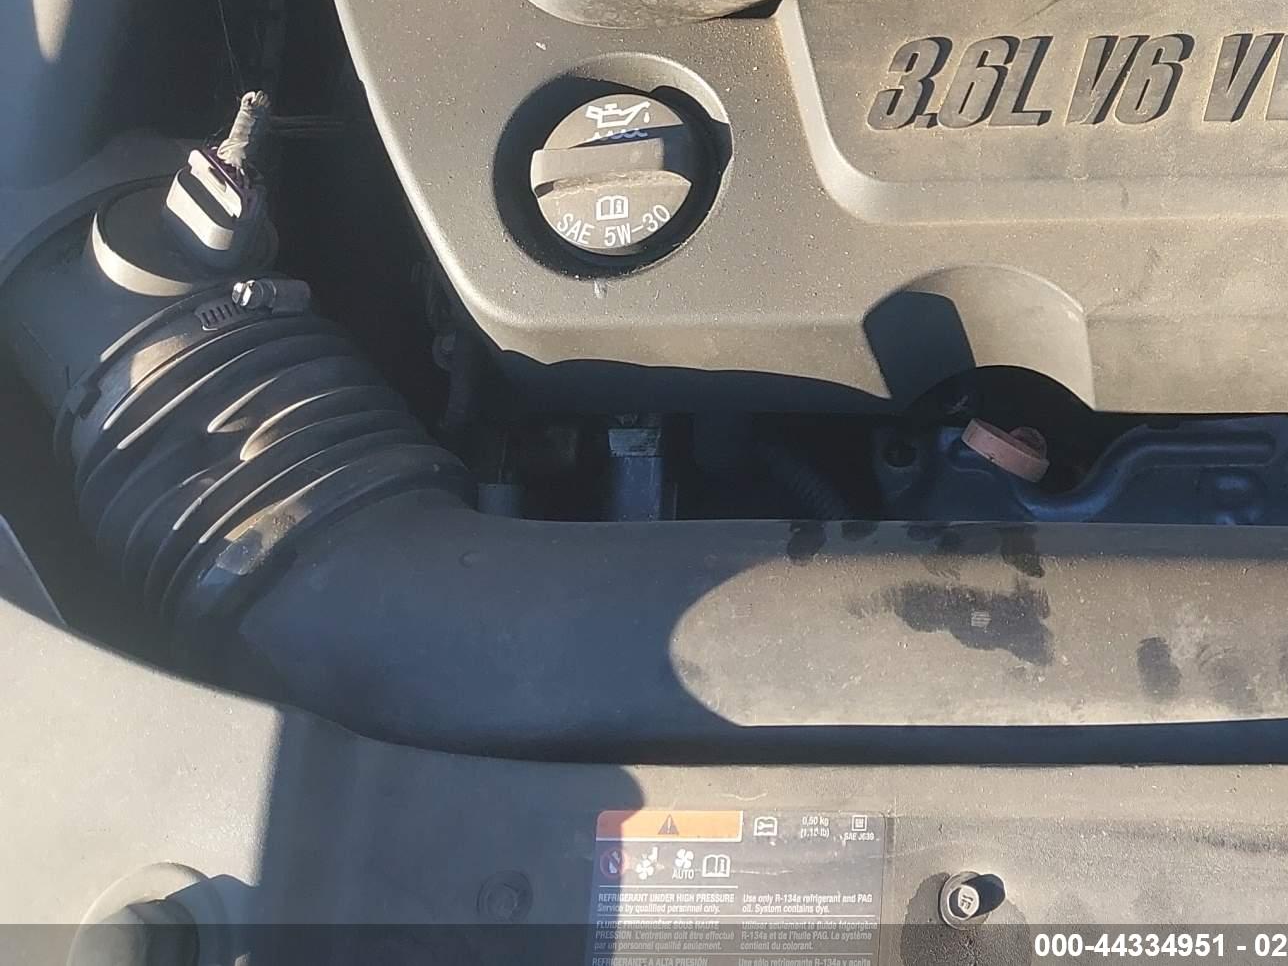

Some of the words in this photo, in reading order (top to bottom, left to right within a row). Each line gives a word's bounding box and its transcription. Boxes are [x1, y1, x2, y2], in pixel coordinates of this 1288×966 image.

[867, 35, 1054, 131] 3.6L
[1066, 34, 1195, 127] V6
[557, 213, 595, 245] SAE
[604, 204, 670, 246] 5W-30
[820, 817, 829, 826] kg
[672, 869, 694, 879] AUTO
[599, 893, 648, 902] REFRIGERANT
[650, 893, 674, 902] UNDER
[676, 893, 694, 902] HIGH
[696, 893, 735, 902] PRESSURE
[744, 894, 756, 902] Use
[758, 894, 773, 904] only
[775, 894, 800, 902] R-134a
[803, 894, 840, 905] refrigerant
[842, 894, 856, 902] and
[858, 894, 872, 902] PAG
[597, 903, 623, 912] Service
[625, 904, 635, 914] by
[635, 904, 665, 914] qualified
[667, 904, 702, 914] personnel
[755, 904, 781, 914] System
[783, 904, 813, 913] contains
[674, 931, 687, 939] doit
[778, 931, 787, 939] de
[831, 931, 839, 939] Le
[772, 942, 780, 950] du
